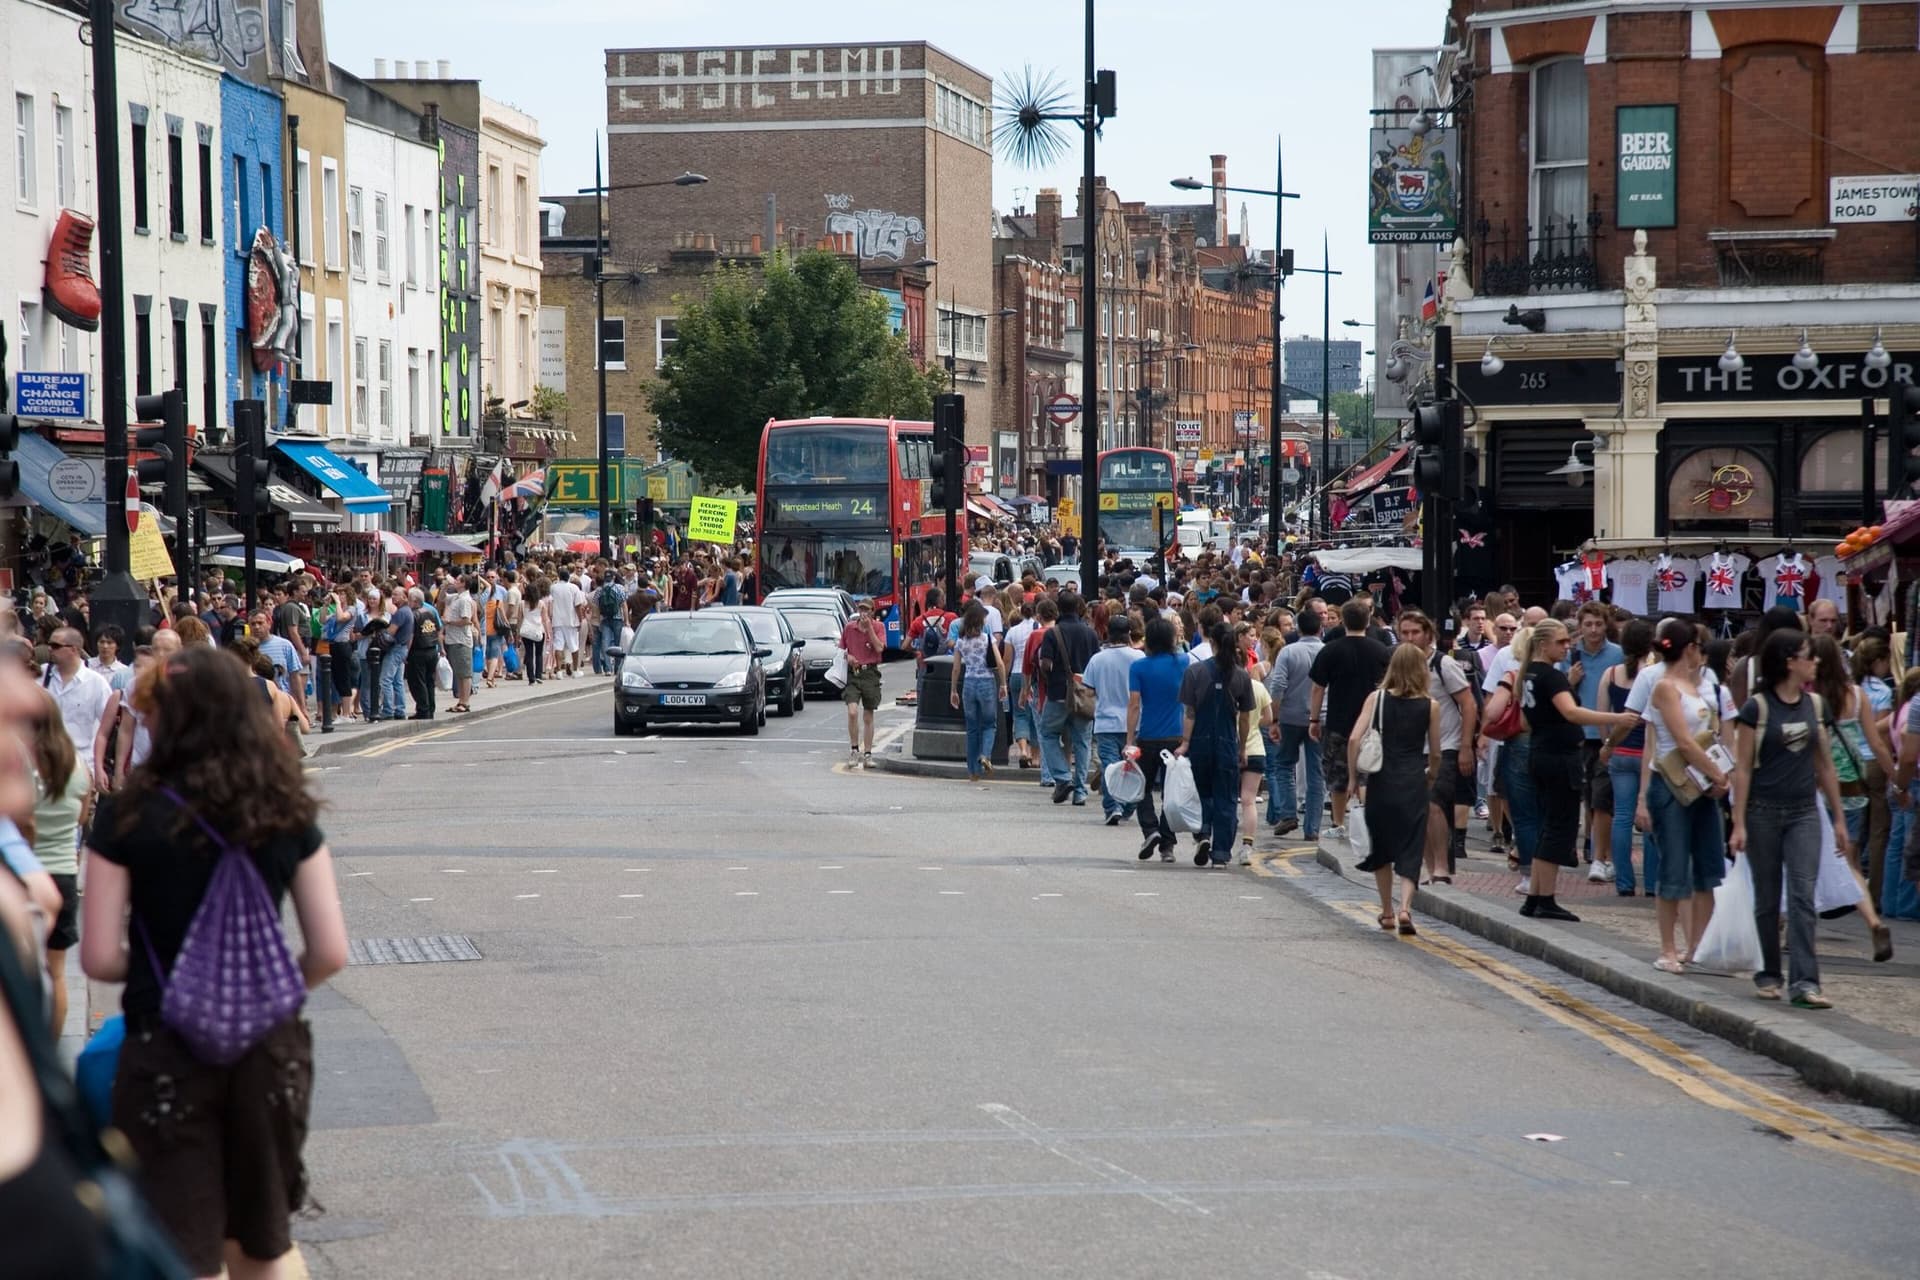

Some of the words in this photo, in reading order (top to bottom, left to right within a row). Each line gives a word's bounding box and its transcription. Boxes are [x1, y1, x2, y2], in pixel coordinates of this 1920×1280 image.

[619, 50, 777, 111] LOGIC
[790, 47, 901, 99] ELMO
[1621, 132, 1672, 154] BEER
[1621, 155, 1671, 171] GARDEN
[1836, 205, 1876, 217] ROAD
[1372, 232, 1417, 241] OXFORD
[1420, 232, 1453, 240] ARMS
[438, 138, 451, 433] PIERCING
[457, 174, 469, 422] TATTOO
[21, 374, 80, 385] BUREAU
[1520, 372, 1546, 389] 265
[1678, 366, 1753, 392] THE
[21, 389, 80, 399] CHANGE
[22, 405, 80, 415] WESCHEL
[781, 503, 820, 513] Hampstead
[822, 502, 842, 511] Heath
[851, 500, 872, 515] 24
